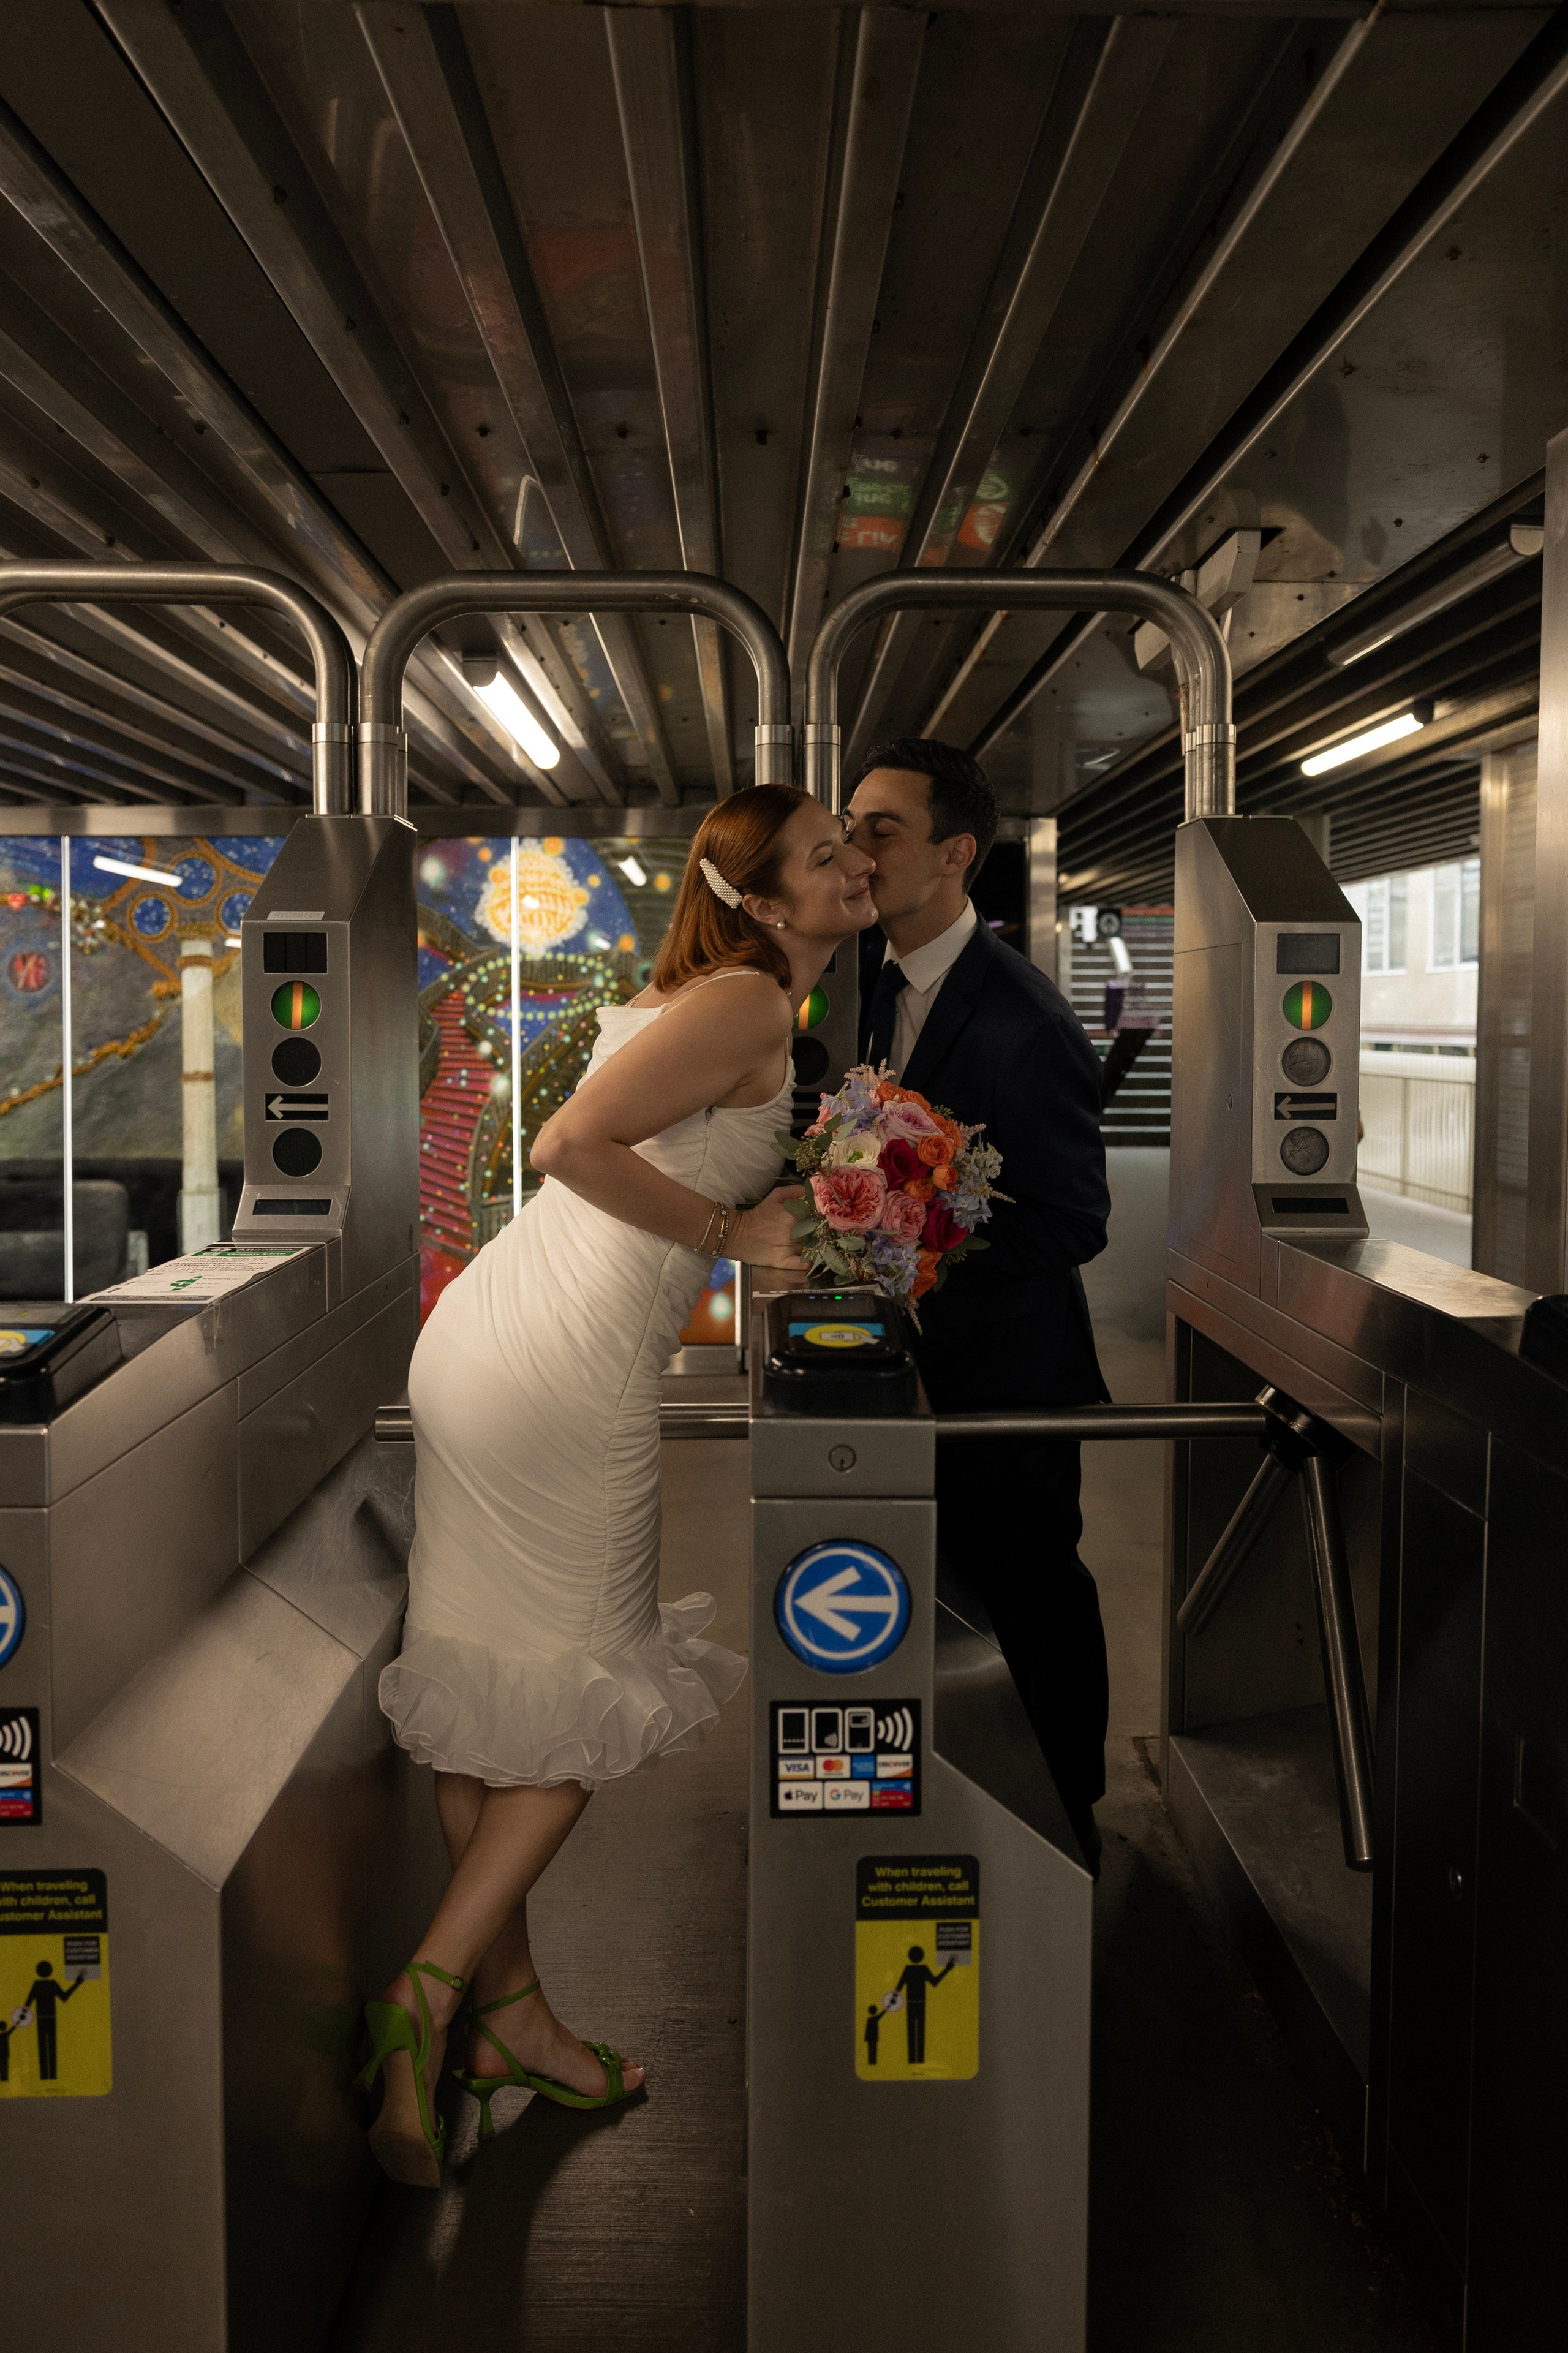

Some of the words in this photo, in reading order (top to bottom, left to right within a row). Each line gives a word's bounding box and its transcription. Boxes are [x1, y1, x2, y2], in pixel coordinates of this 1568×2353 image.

[785, 1763, 809, 1772] VISA
[796, 1790, 818, 1803] Pay
[844, 1789, 864, 1802] Pay
[875, 1867, 908, 1878] When
[911, 1866, 962, 1879] traveling
[867, 1881, 892, 1892] with
[894, 1881, 945, 1892] children,
[948, 1880, 970, 1891] call
[862, 1896, 918, 1907] Customer
[921, 1895, 975, 1906] Assistant
